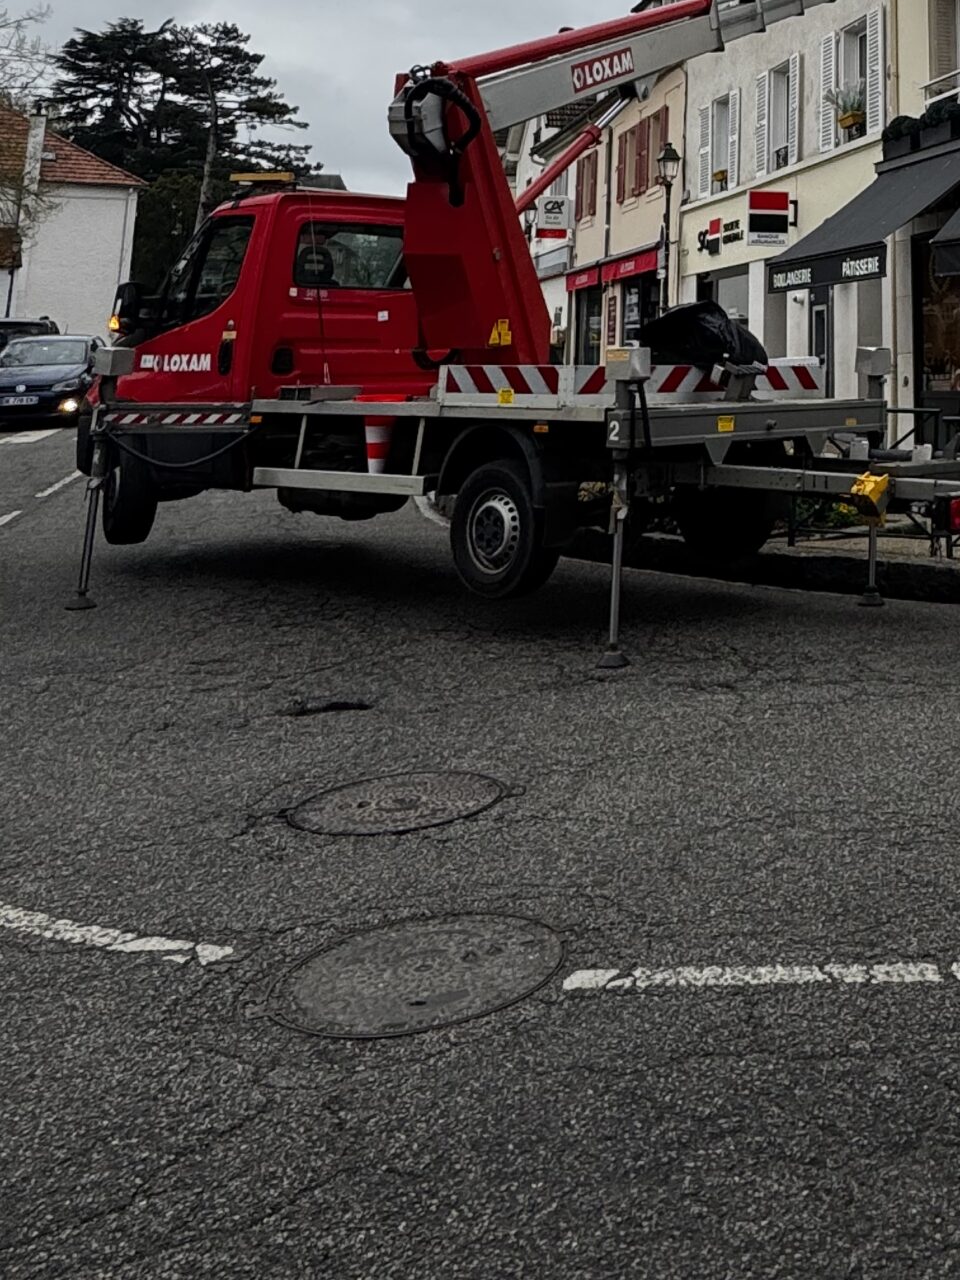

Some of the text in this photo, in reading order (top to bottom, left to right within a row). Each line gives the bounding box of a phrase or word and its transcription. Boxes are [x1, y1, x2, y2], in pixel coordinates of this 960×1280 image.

[584, 51, 634, 85] LOXAM
[773, 257, 879, 289] BOULANGERIE PÂTISSERIE
[163, 353, 212, 372] LOXAM
[609, 420, 620, 441] 2
